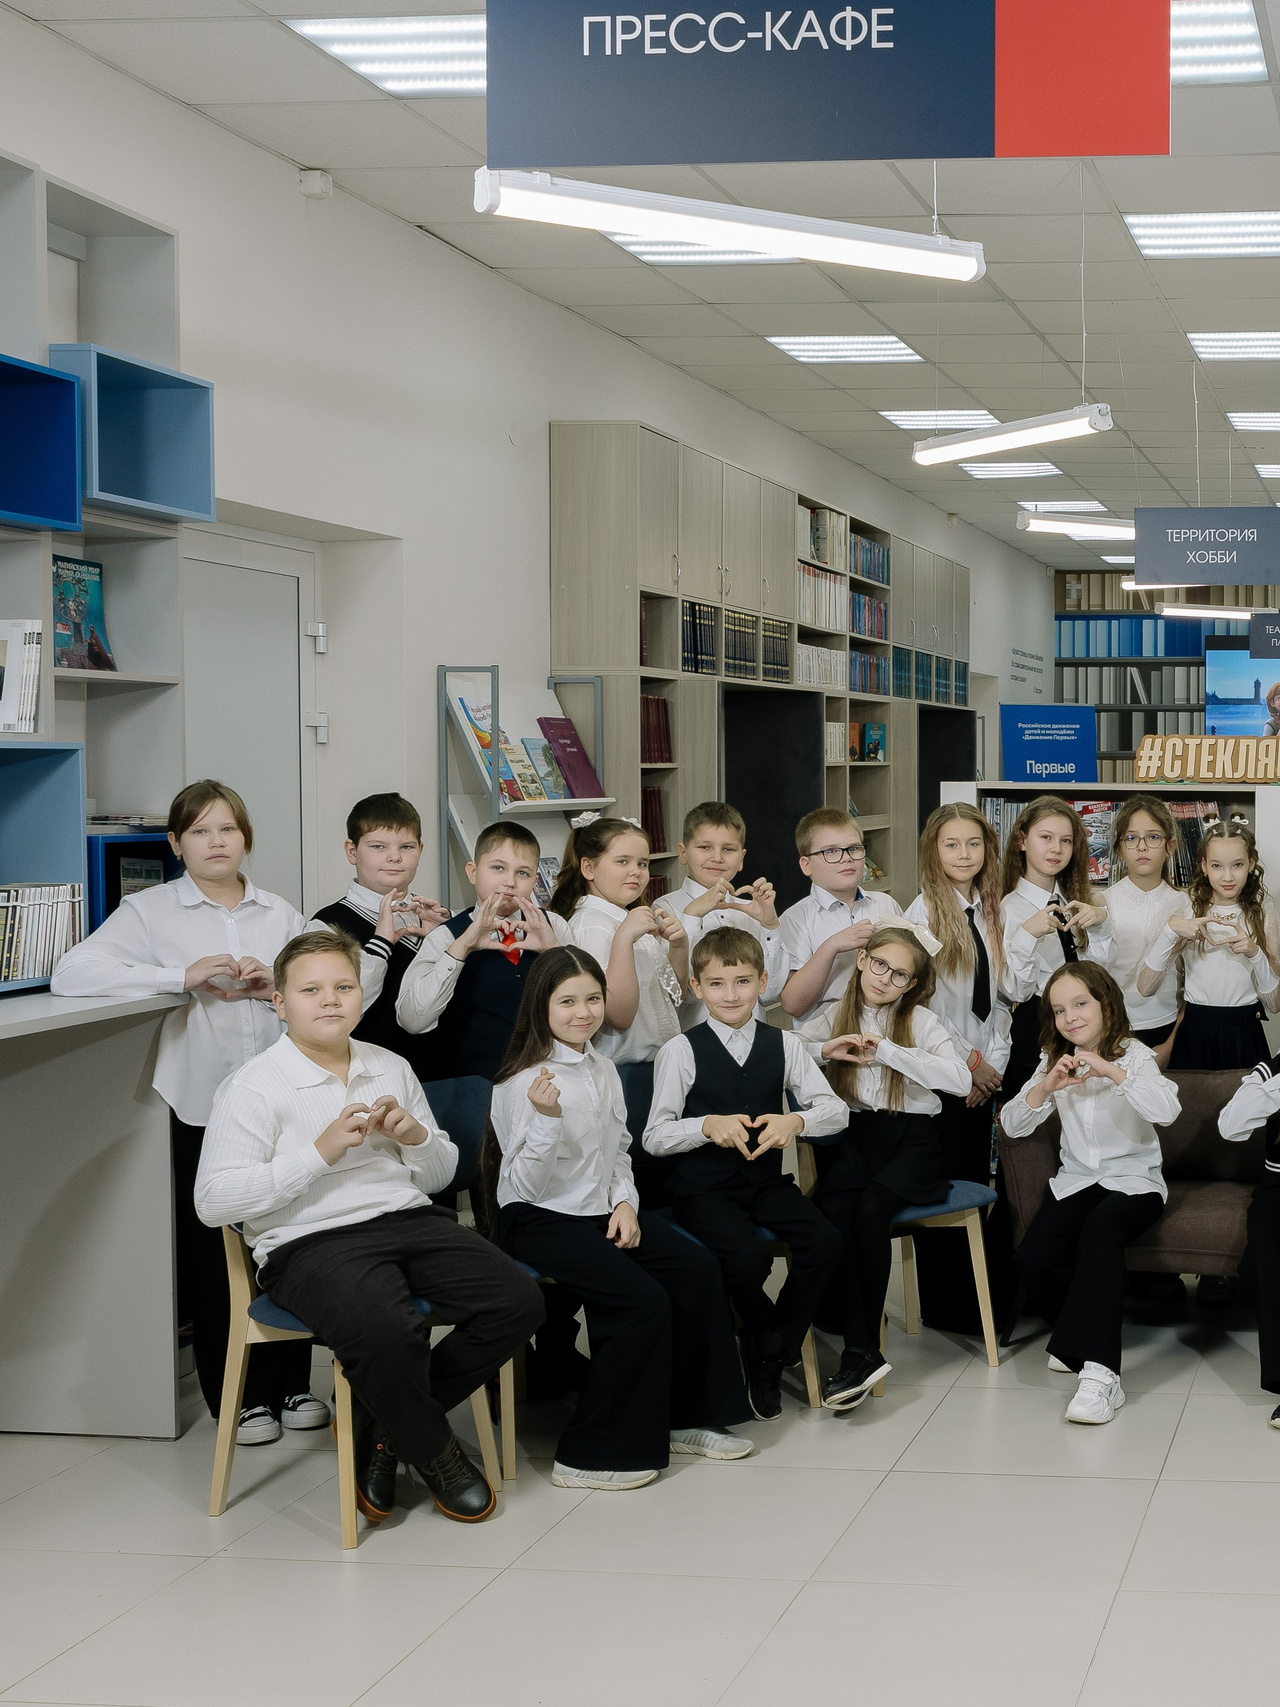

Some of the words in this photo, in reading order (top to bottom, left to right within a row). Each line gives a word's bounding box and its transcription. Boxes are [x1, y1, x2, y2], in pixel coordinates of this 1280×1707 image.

[583, 6, 894, 56] ПРЕСС-КАФЕ
[1166, 529, 1257, 542] ТЕРРИТОРИЯ
[1186, 551, 1237, 564] ХОББИ
[1026, 760, 1076, 778] Первые
